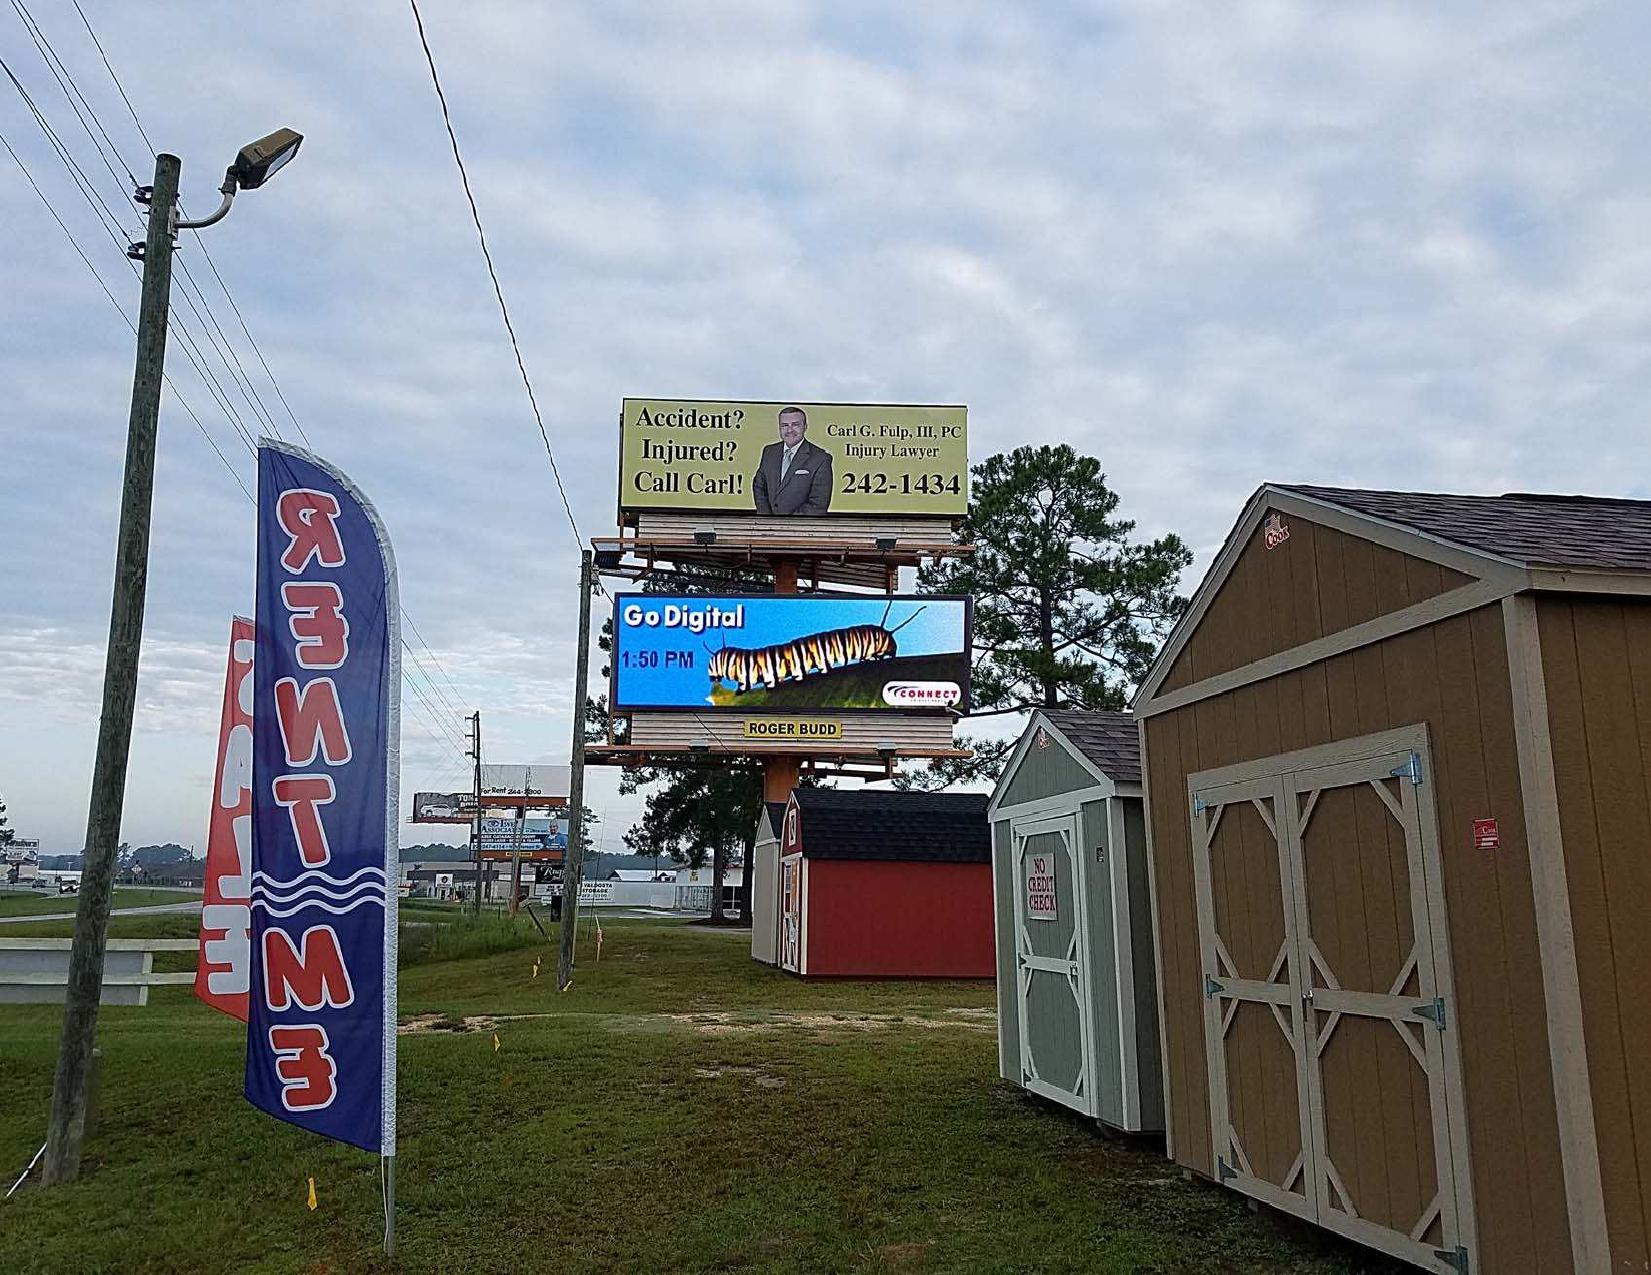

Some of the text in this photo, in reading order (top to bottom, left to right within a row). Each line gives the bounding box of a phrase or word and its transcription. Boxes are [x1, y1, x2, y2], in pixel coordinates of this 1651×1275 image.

[635, 406, 744, 430] Accident?
[827, 424, 962, 440] Carl G. Fulp, III, PC
[641, 438, 738, 465] Injured?
[845, 443, 940, 459] Injury Lawyer
[634, 471, 744, 496] Call Carl!
[841, 473, 961, 496] 242-1434
[623, 605, 744, 633] Go Digital
[622, 650, 694, 669] 1:50 PM
[900, 690, 957, 698] CONNECT
[749, 722, 837, 735] ROGER BUDD
[492, 786, 507, 794] Rent
[1033, 858, 1046, 874] NO
[1028, 876, 1054, 893] CREDIT
[1029, 895, 1056, 912] CHECK
